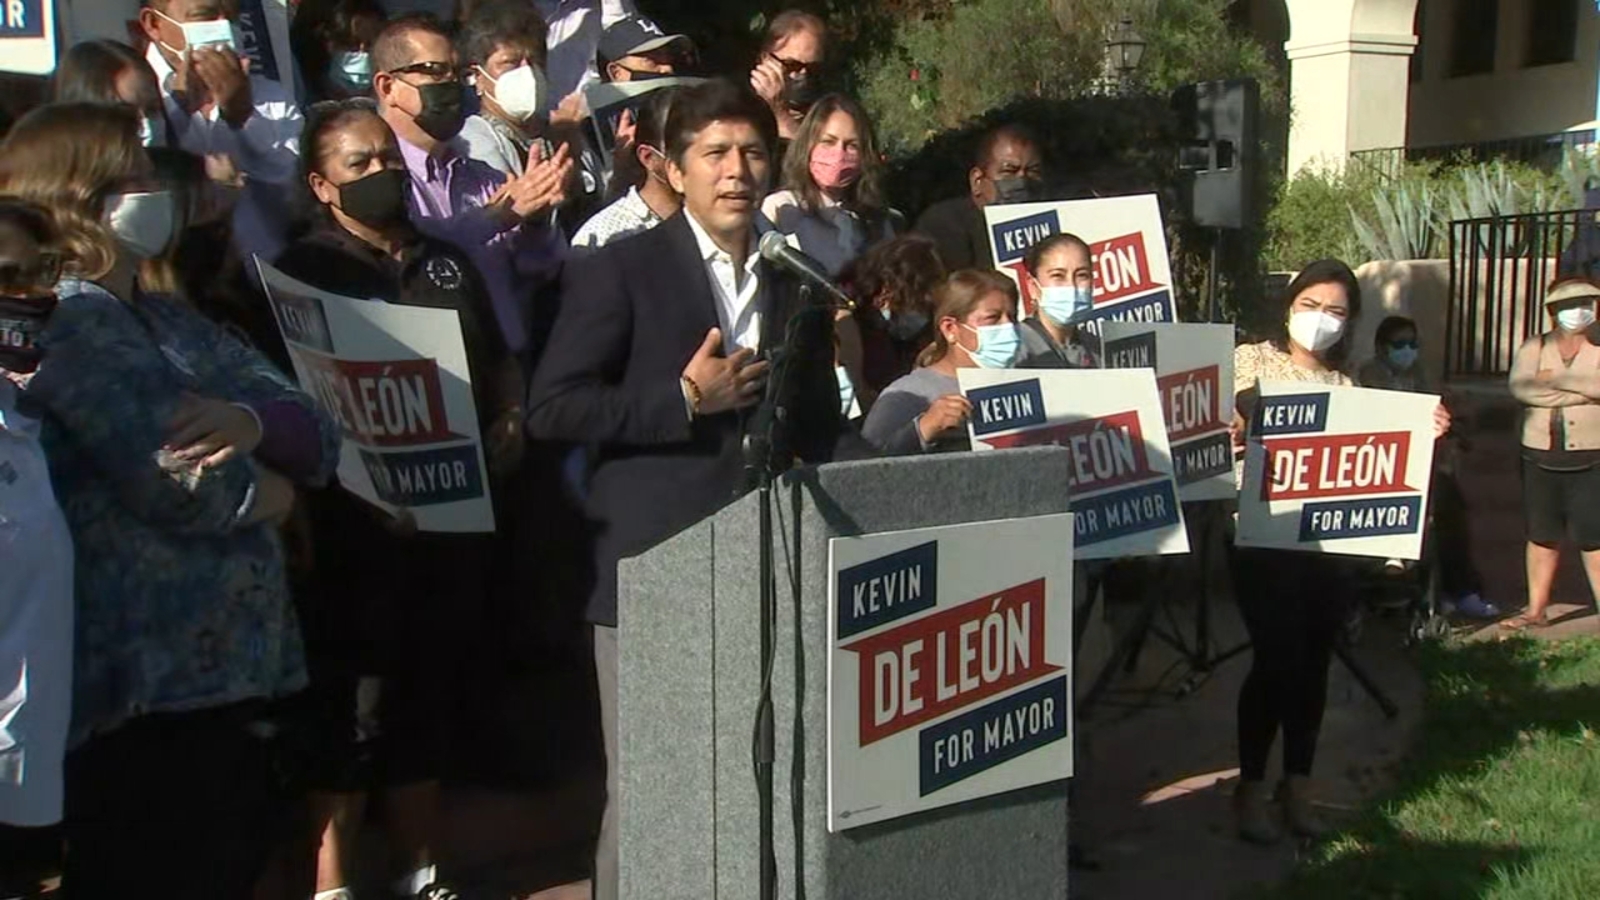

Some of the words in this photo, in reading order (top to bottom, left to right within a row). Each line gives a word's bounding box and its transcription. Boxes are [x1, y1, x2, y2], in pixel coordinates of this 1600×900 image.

[1003, 222, 1051, 252] KEVIN
[1091, 242, 1141, 297] EÓN
[1111, 345, 1149, 369] KEVIN
[344, 365, 432, 436] LEÓN
[980, 392, 1033, 424] KEVIN
[1262, 404, 1317, 427] KEVIN
[1186, 443, 1226, 472] MAYOR
[1272, 447, 1314, 493] DE
[1318, 436, 1398, 490] LEÓN
[397, 461, 467, 494] MAYOR
[1075, 512, 1098, 535] OR
[1105, 493, 1167, 529] MAYOR
[1311, 510, 1344, 532] FOR
[1349, 505, 1410, 530] MAYOR
[853, 564, 921, 619] KEVIN
[874, 639, 924, 727] DE
[936, 597, 1031, 702] LEÓN
[934, 731, 974, 774] FOR
[984, 697, 1055, 753] MAYOR
